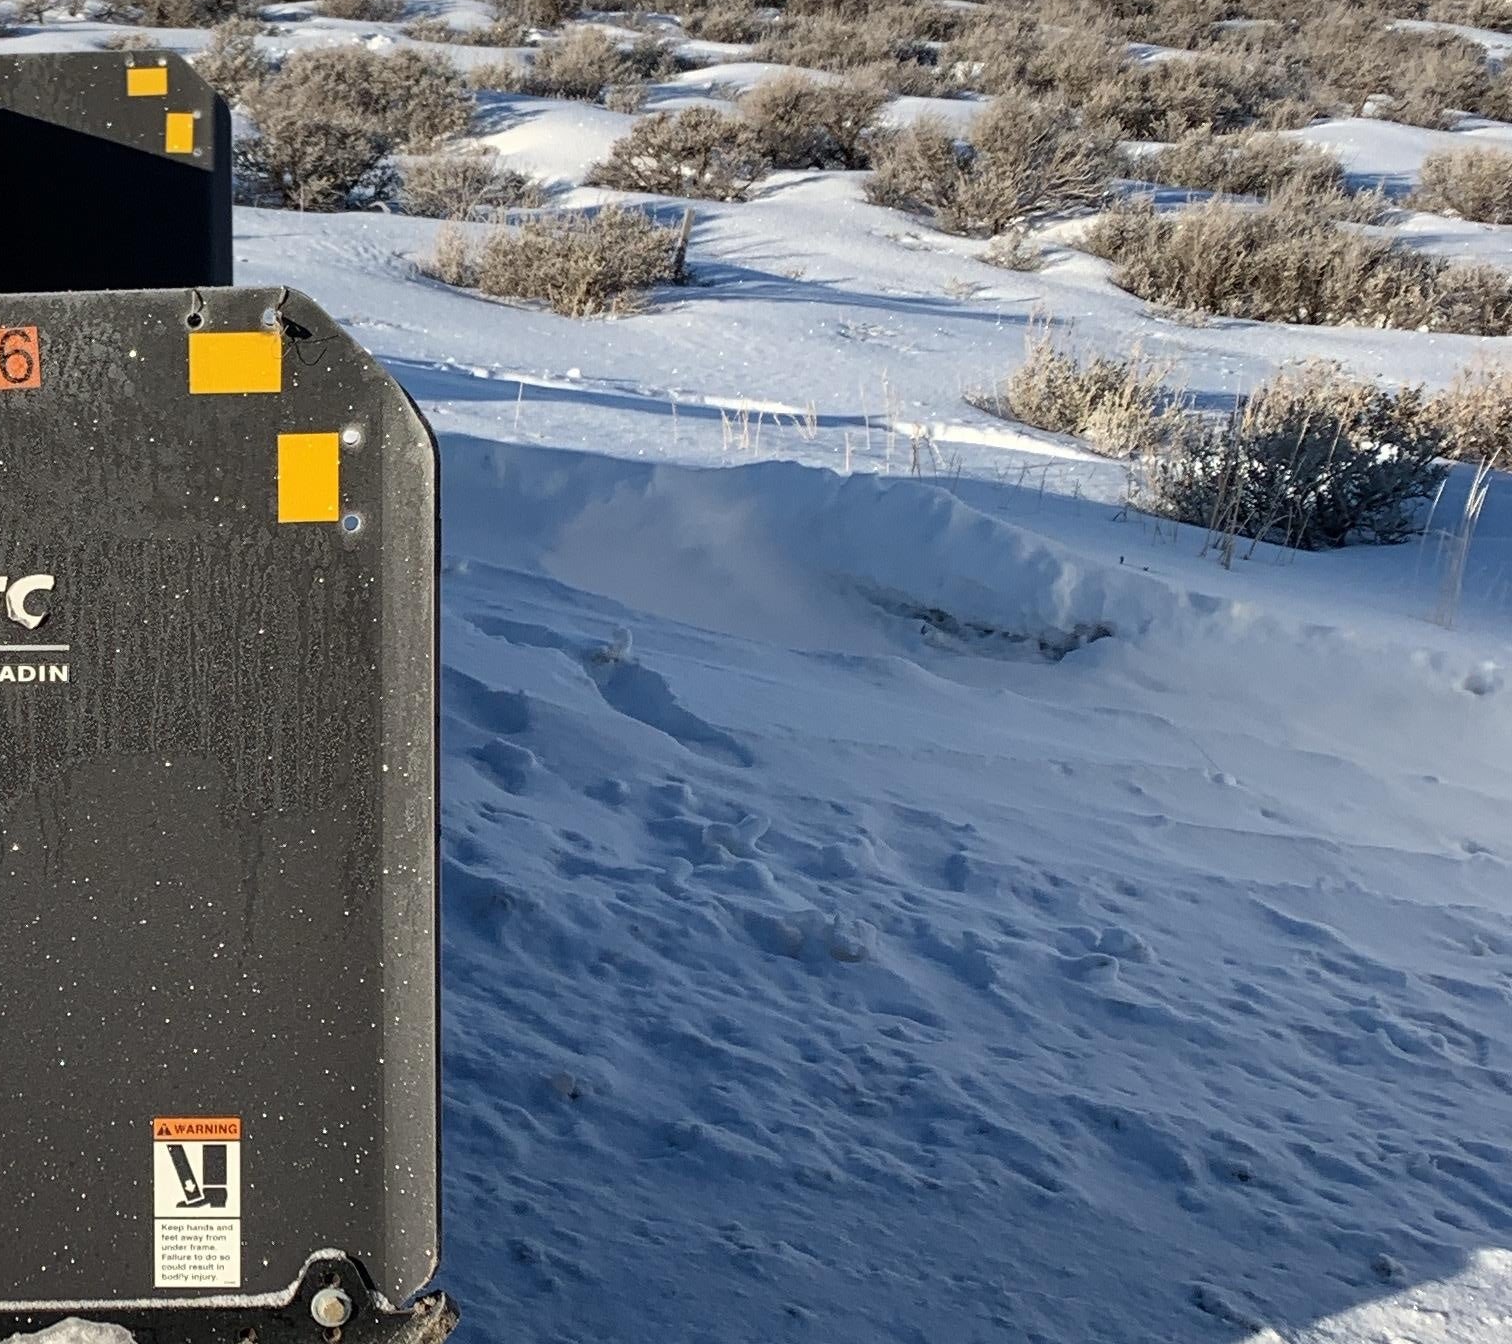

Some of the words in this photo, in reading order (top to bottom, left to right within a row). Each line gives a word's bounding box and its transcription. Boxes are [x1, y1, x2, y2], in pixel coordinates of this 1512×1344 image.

[174, 1123, 238, 1135] WARNING
[161, 1224, 184, 1232] Keep
[161, 1253, 191, 1261] Failure
[161, 1273, 188, 1281] bodily
